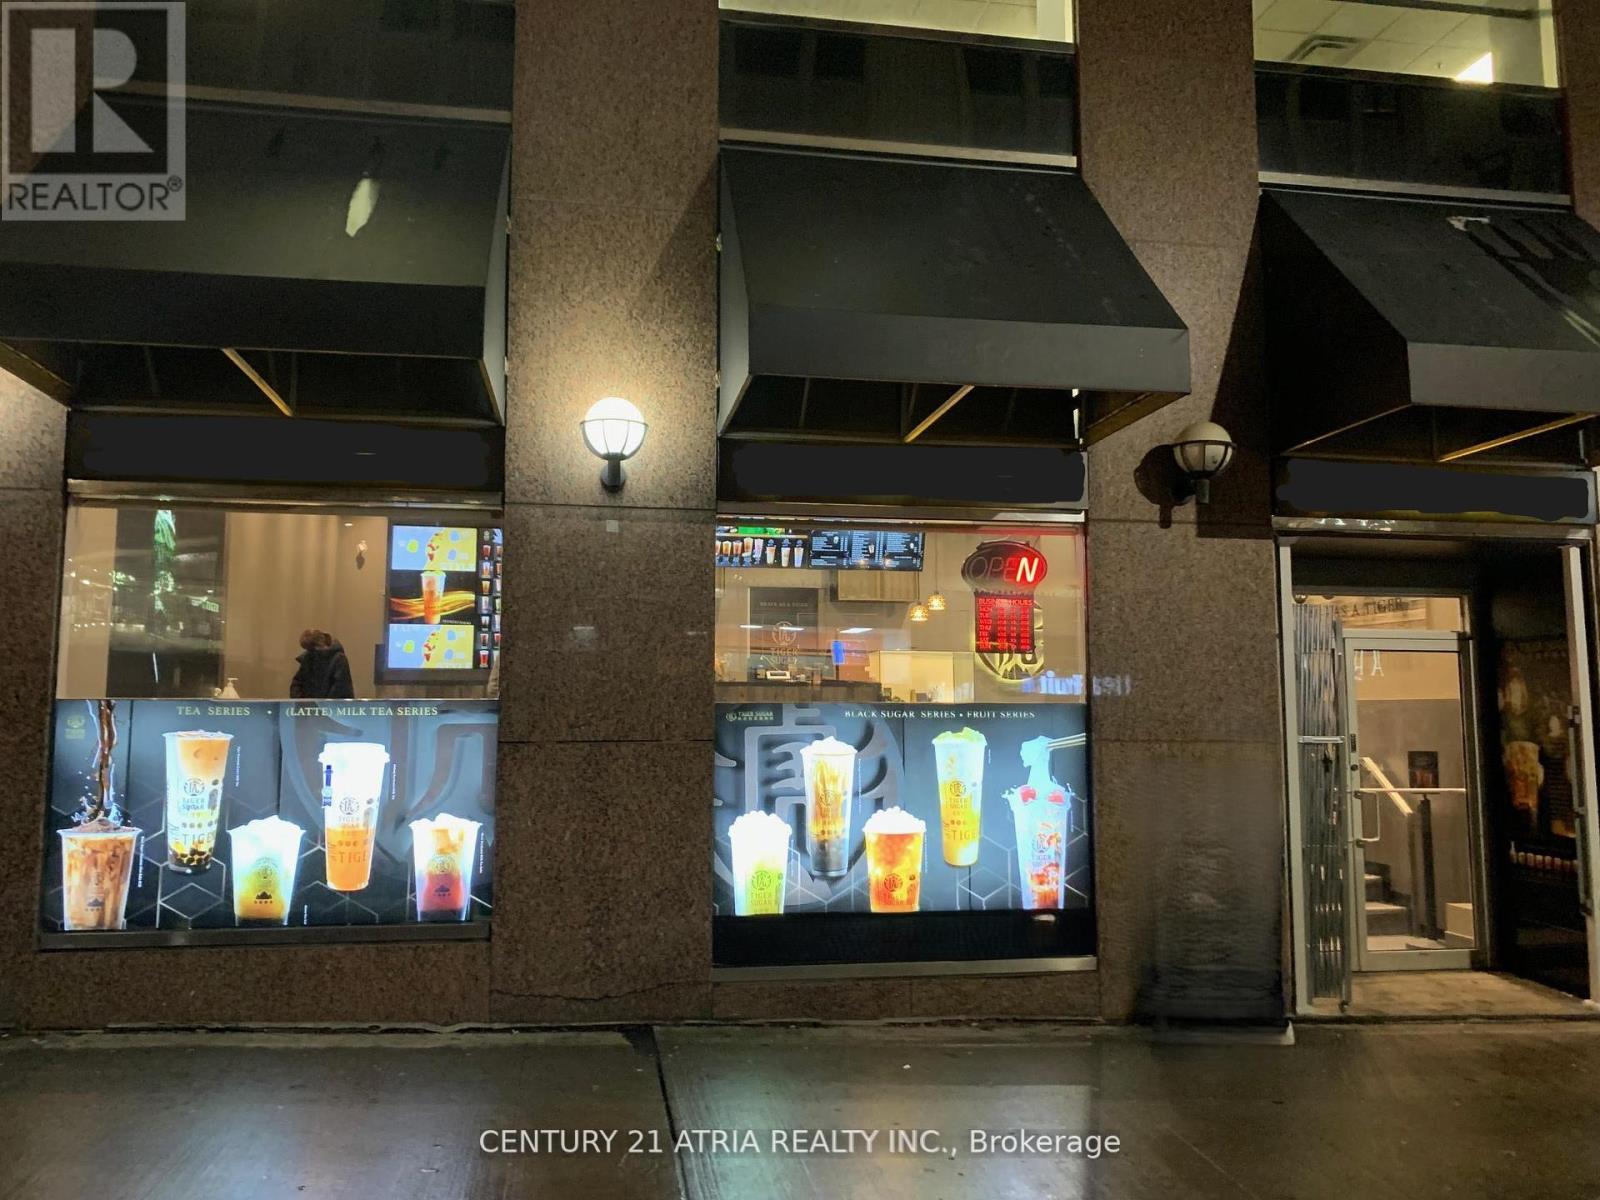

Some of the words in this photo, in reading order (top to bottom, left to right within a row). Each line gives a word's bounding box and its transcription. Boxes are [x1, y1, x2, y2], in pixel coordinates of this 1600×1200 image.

[966, 556, 1039, 582] OPEN
[1351, 604, 1360, 617] A
[177, 706, 200, 716] TEA
[207, 706, 250, 716] SERIES
[285, 706, 333, 717] (LATTE)
[336, 706, 366, 716] MILK
[371, 706, 393, 716] TEA
[396, 706, 438, 716] SERIES
[845, 710, 878, 718] BLACK
[880, 710, 915, 718] SUGAR
[920, 711, 956, 719] SERIES
[967, 711, 997, 719] FRUIT
[1000, 711, 1036, 719] SERIES
